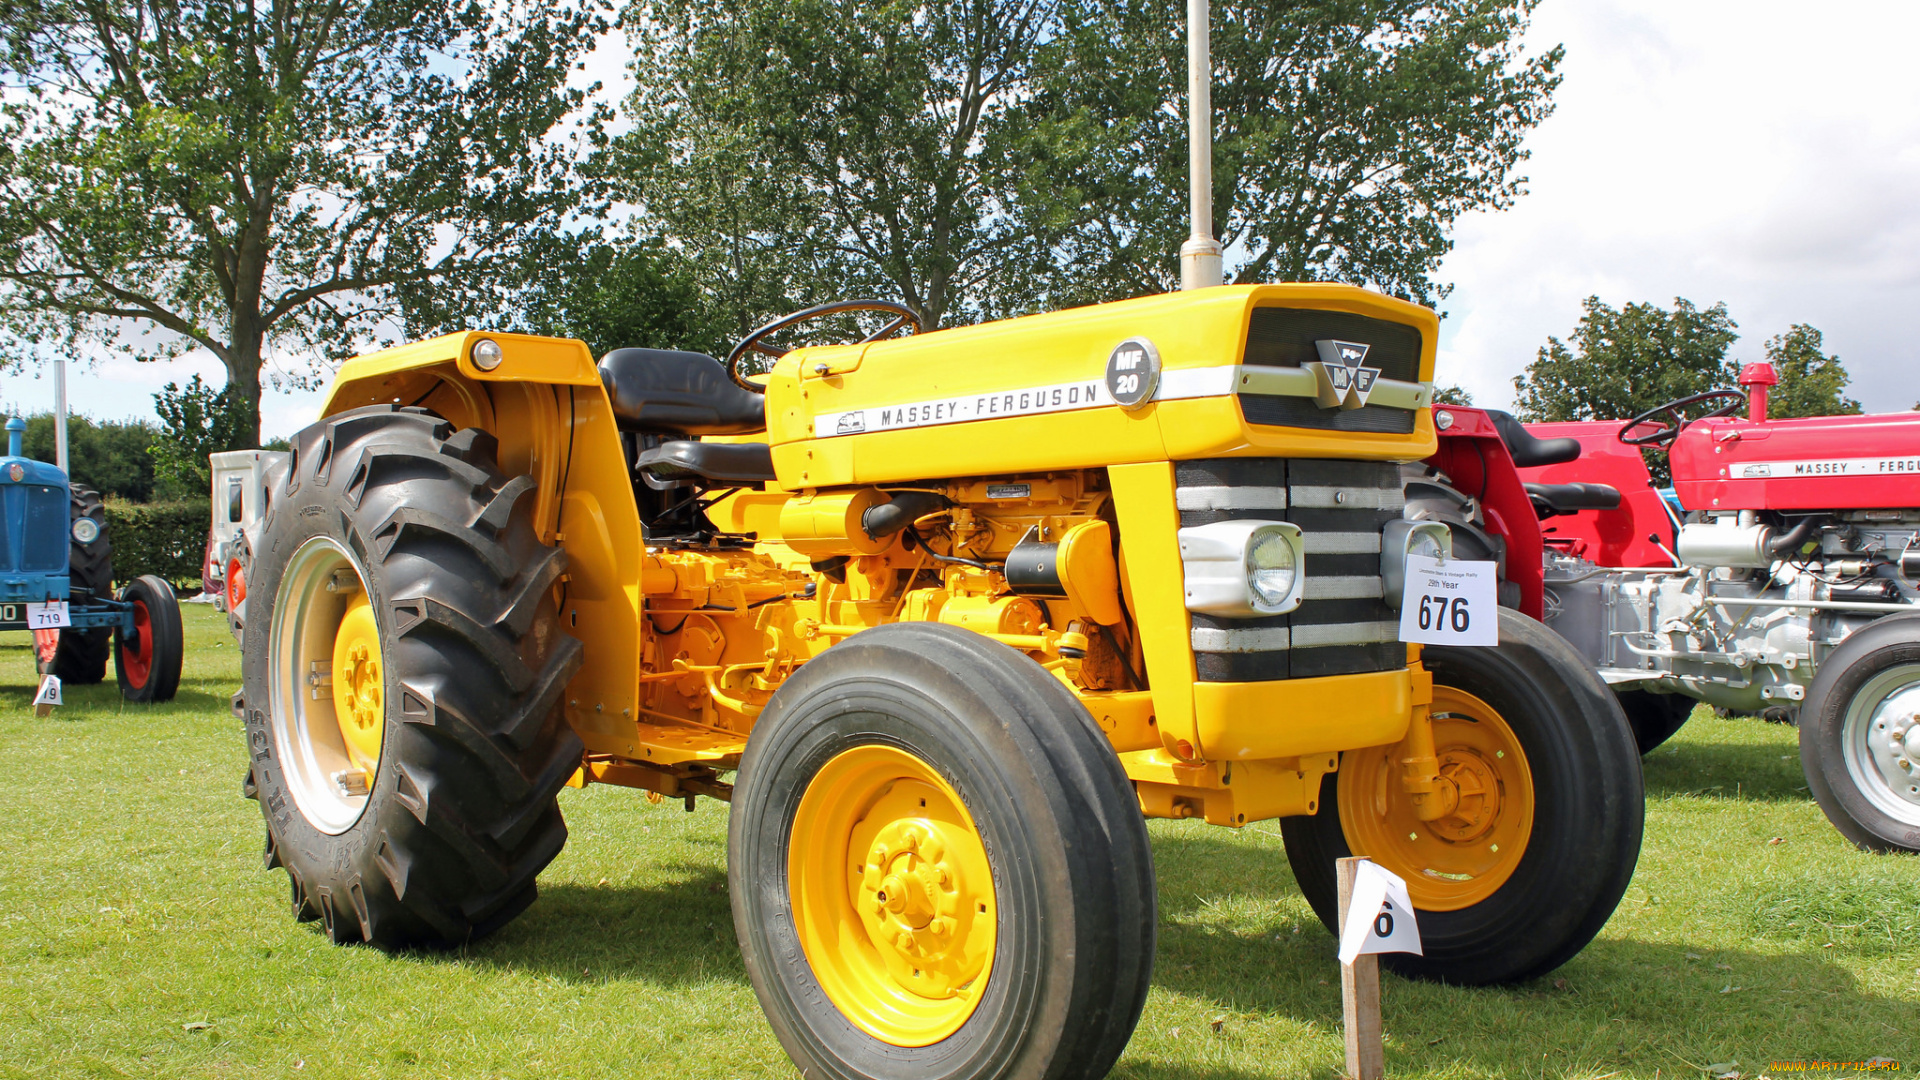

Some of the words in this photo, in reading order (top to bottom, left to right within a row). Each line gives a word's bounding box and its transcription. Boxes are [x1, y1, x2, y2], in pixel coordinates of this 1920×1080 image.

[1115, 350, 1143, 371] MF
[1115, 373, 1139, 394] 20
[881, 401, 957, 426] MASSEY
[976, 384, 1096, 415] FERGUSON
[1795, 463, 1847, 474] MASSEY
[1441, 580, 1459, 589] Year
[37, 613, 61, 624] 719
[1419, 595, 1470, 632] 676
